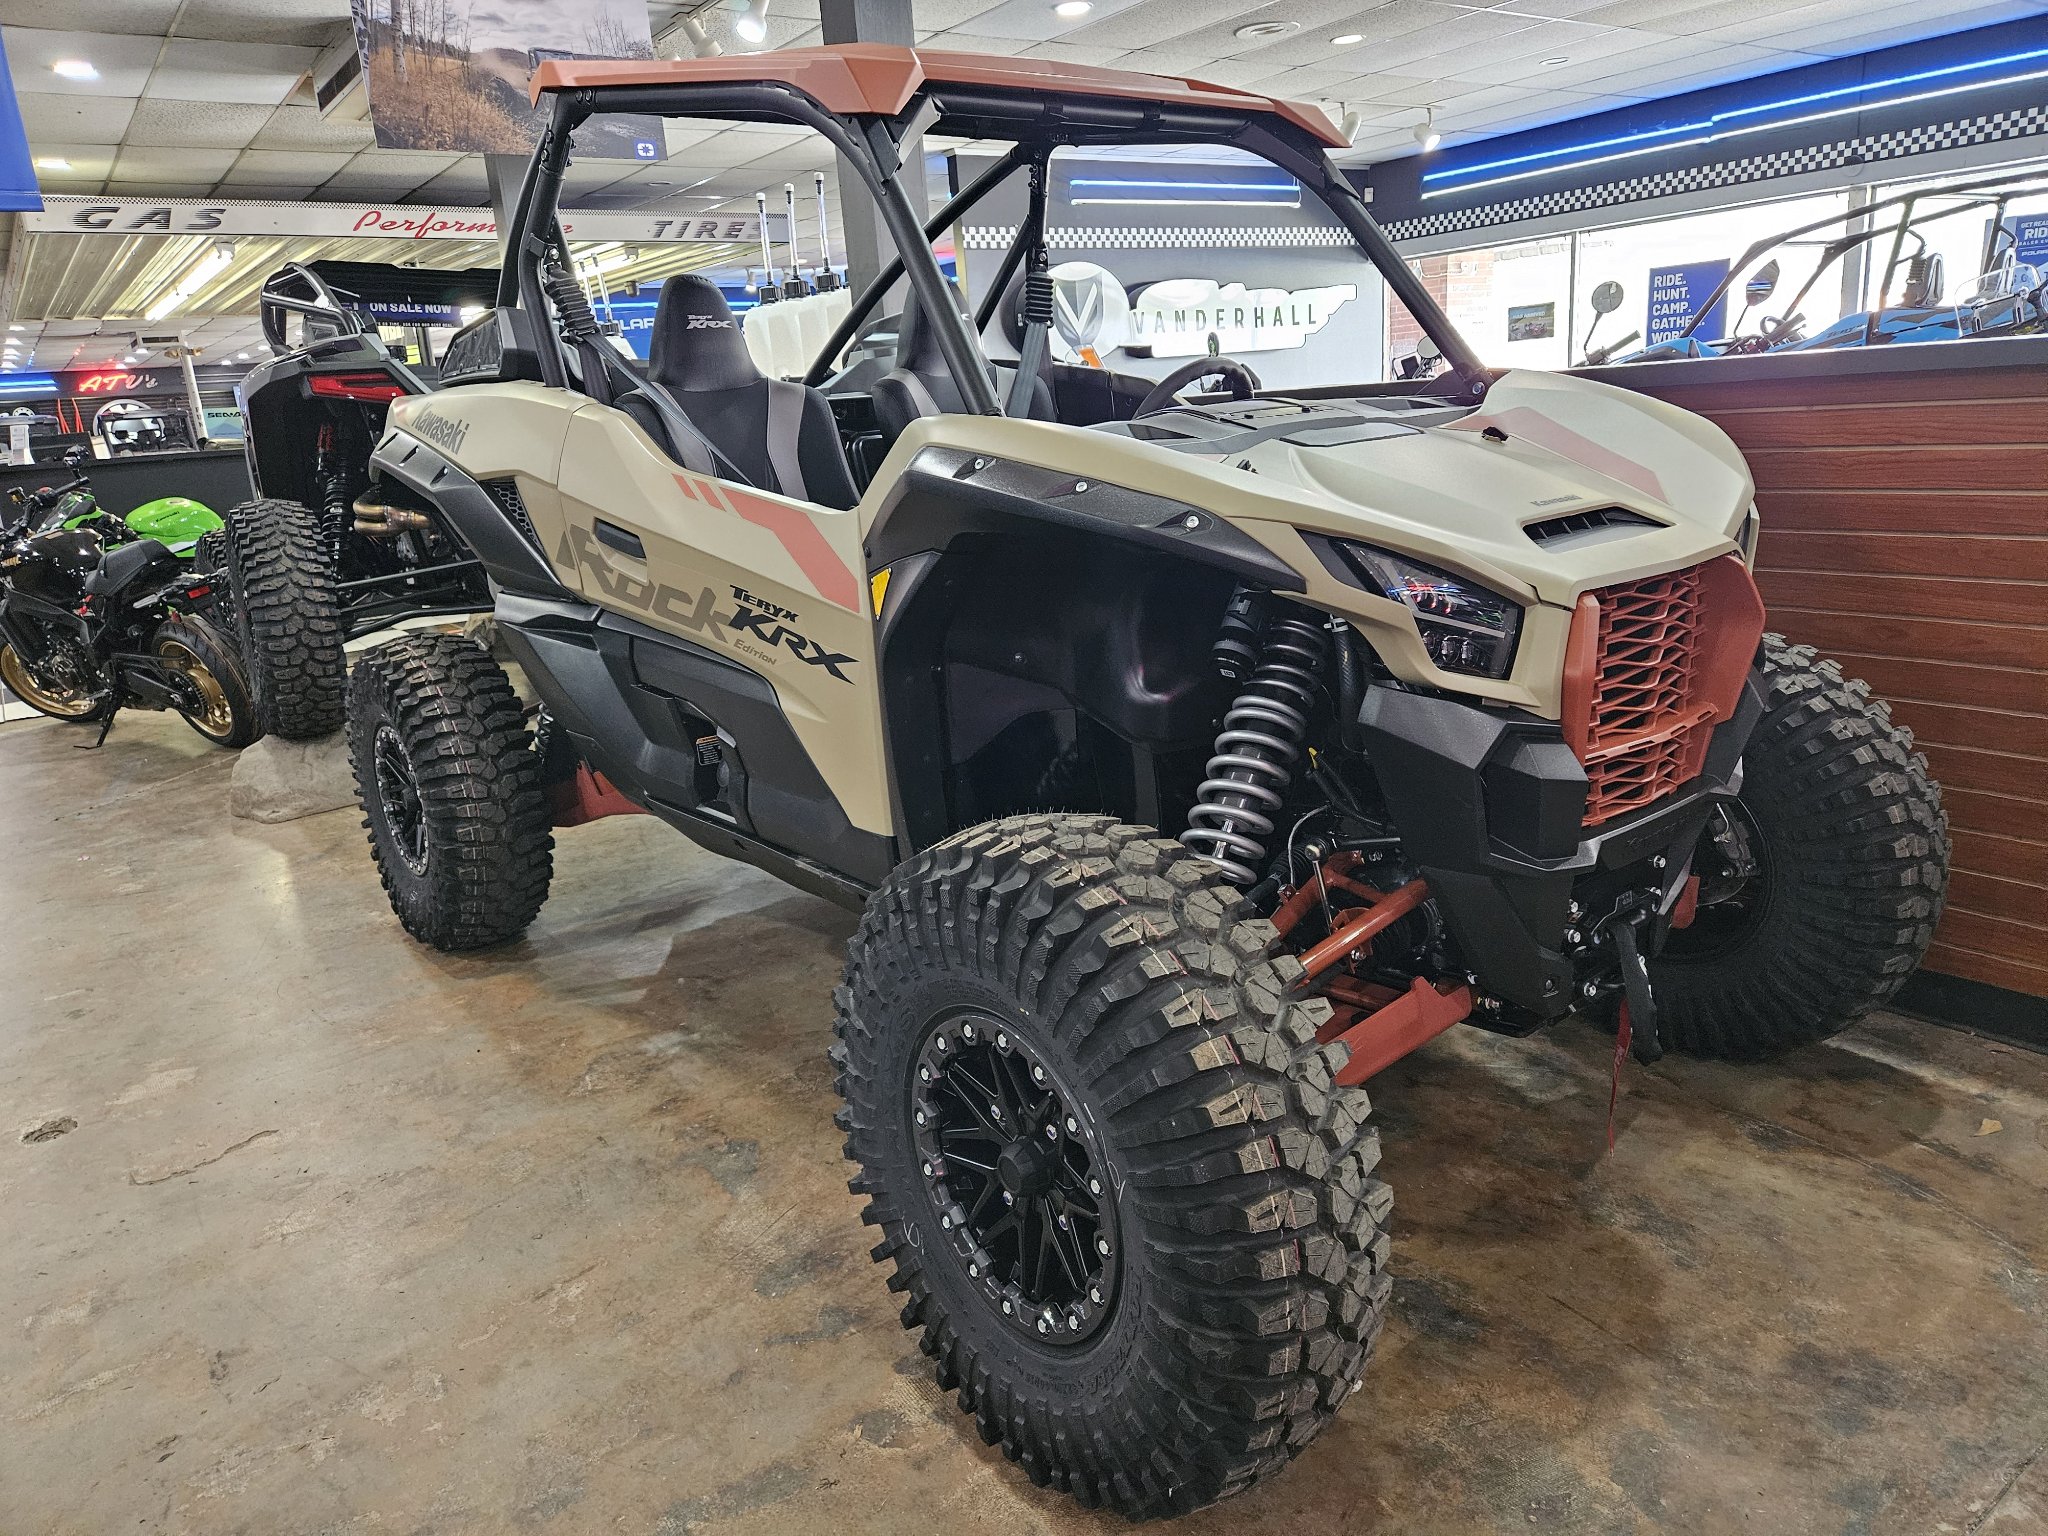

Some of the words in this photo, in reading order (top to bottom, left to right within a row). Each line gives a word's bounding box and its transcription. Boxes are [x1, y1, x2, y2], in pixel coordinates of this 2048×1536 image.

[70, 206, 227, 230] GAS
[352, 210, 574, 239] Performe
[1653, 272, 1687, 288] RIDE.
[1652, 286, 1690, 302] HUNT.
[370, 302, 388, 312] ON
[389, 303, 423, 313] SALE
[424, 304, 452, 314] NOW
[1651, 301, 1692, 316] CAMP.
[686, 319, 733, 330] KRX
[1132, 303, 1317, 335] VANDERHALL
[1650, 314, 1705, 330] GATHE.
[78, 373, 159, 393] ATV's
[411, 402, 470, 455] Kawasaki
[728, 602, 861, 686] KRX
